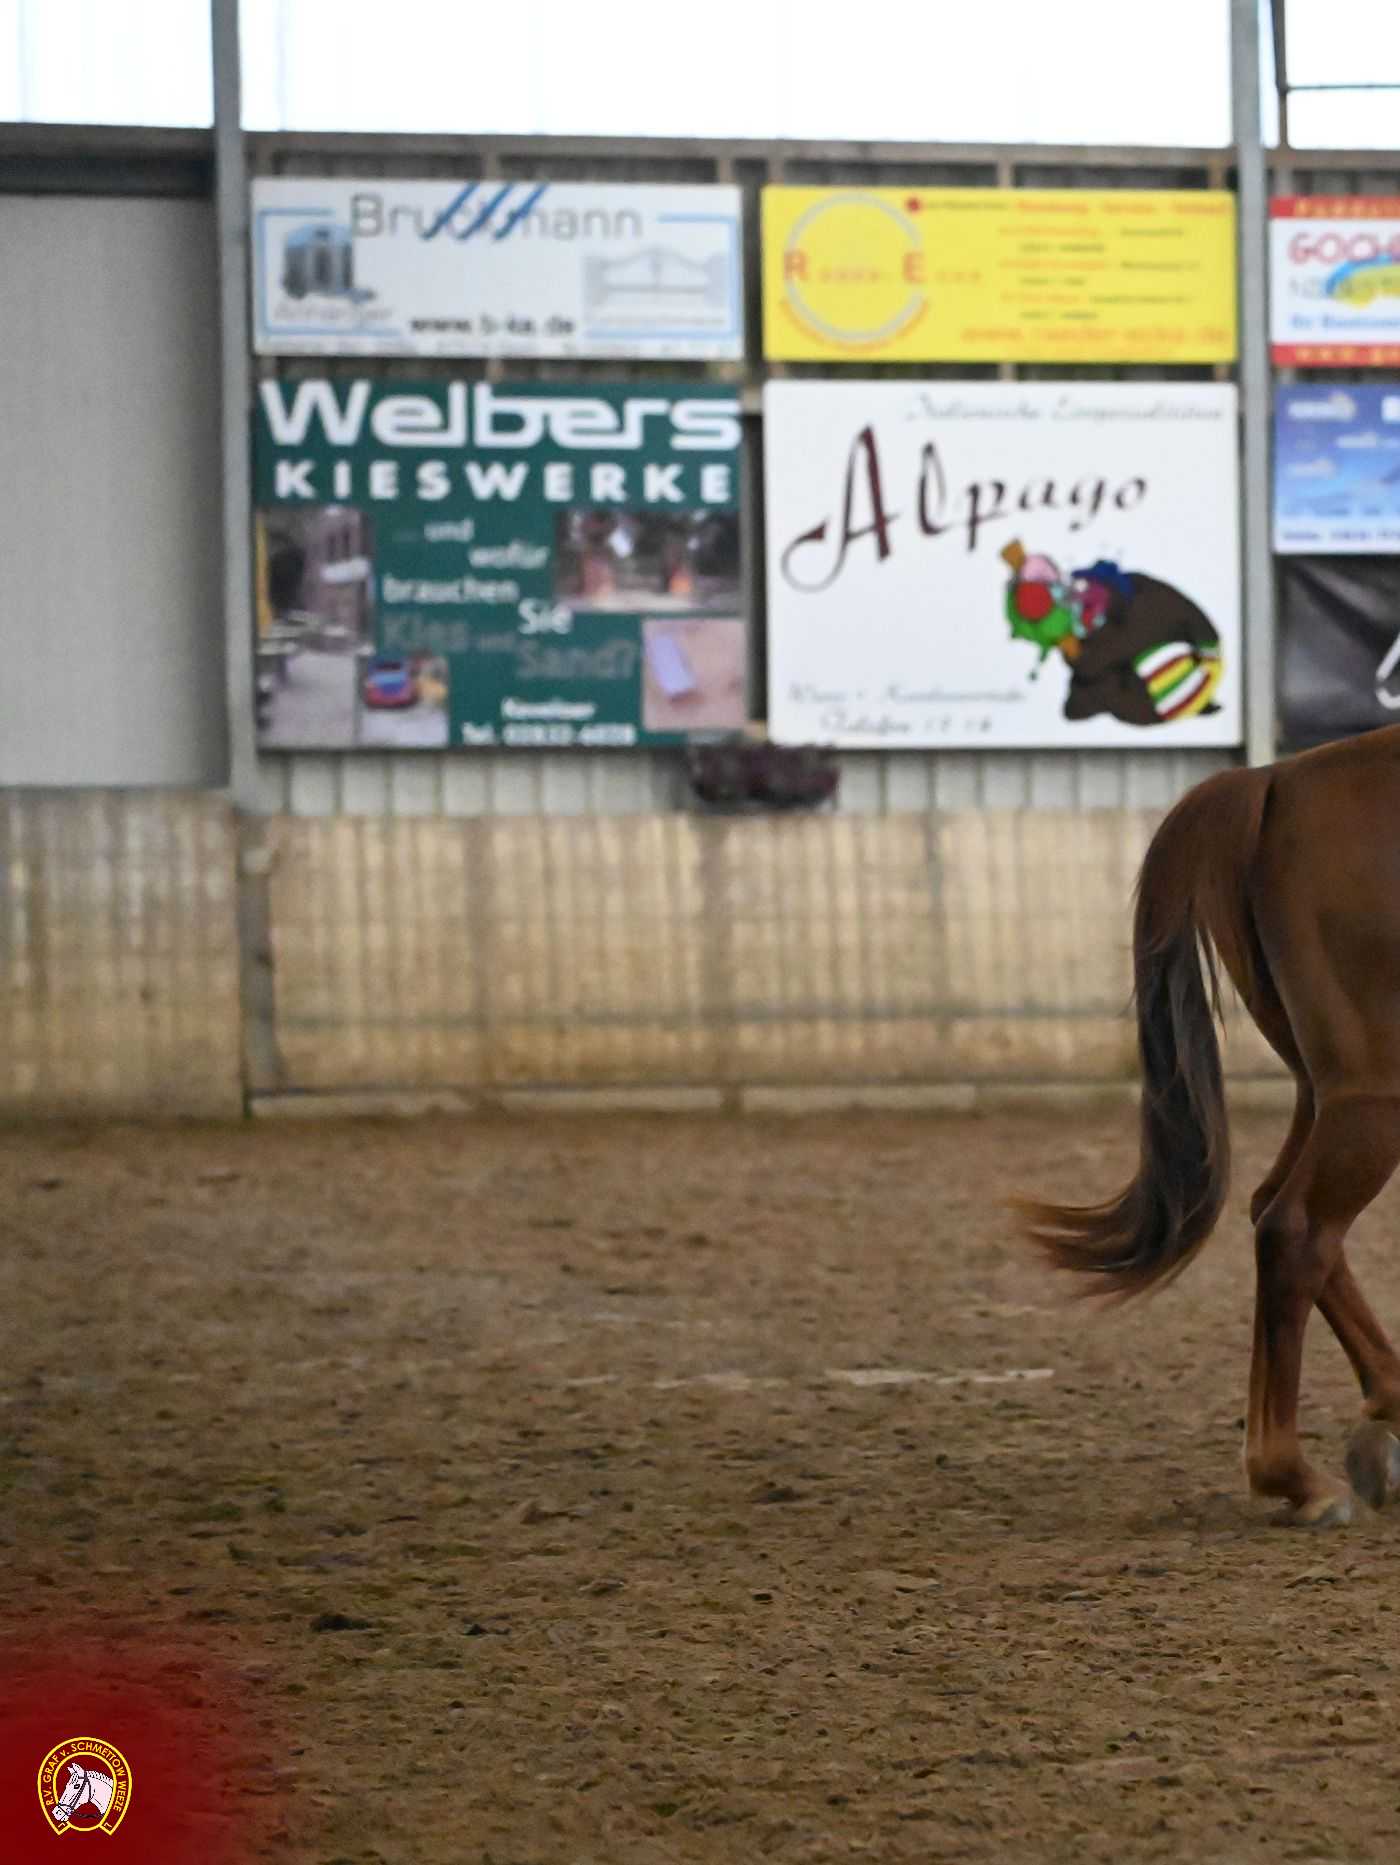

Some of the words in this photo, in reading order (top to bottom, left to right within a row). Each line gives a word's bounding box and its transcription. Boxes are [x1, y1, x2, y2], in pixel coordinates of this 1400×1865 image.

[258, 378, 744, 450] Welbers
[273, 460, 733, 503] KIESWERKE
[781, 425, 1148, 593] Alpago
[383, 575, 521, 604] brauchen
[518, 598, 573, 635] Sie
